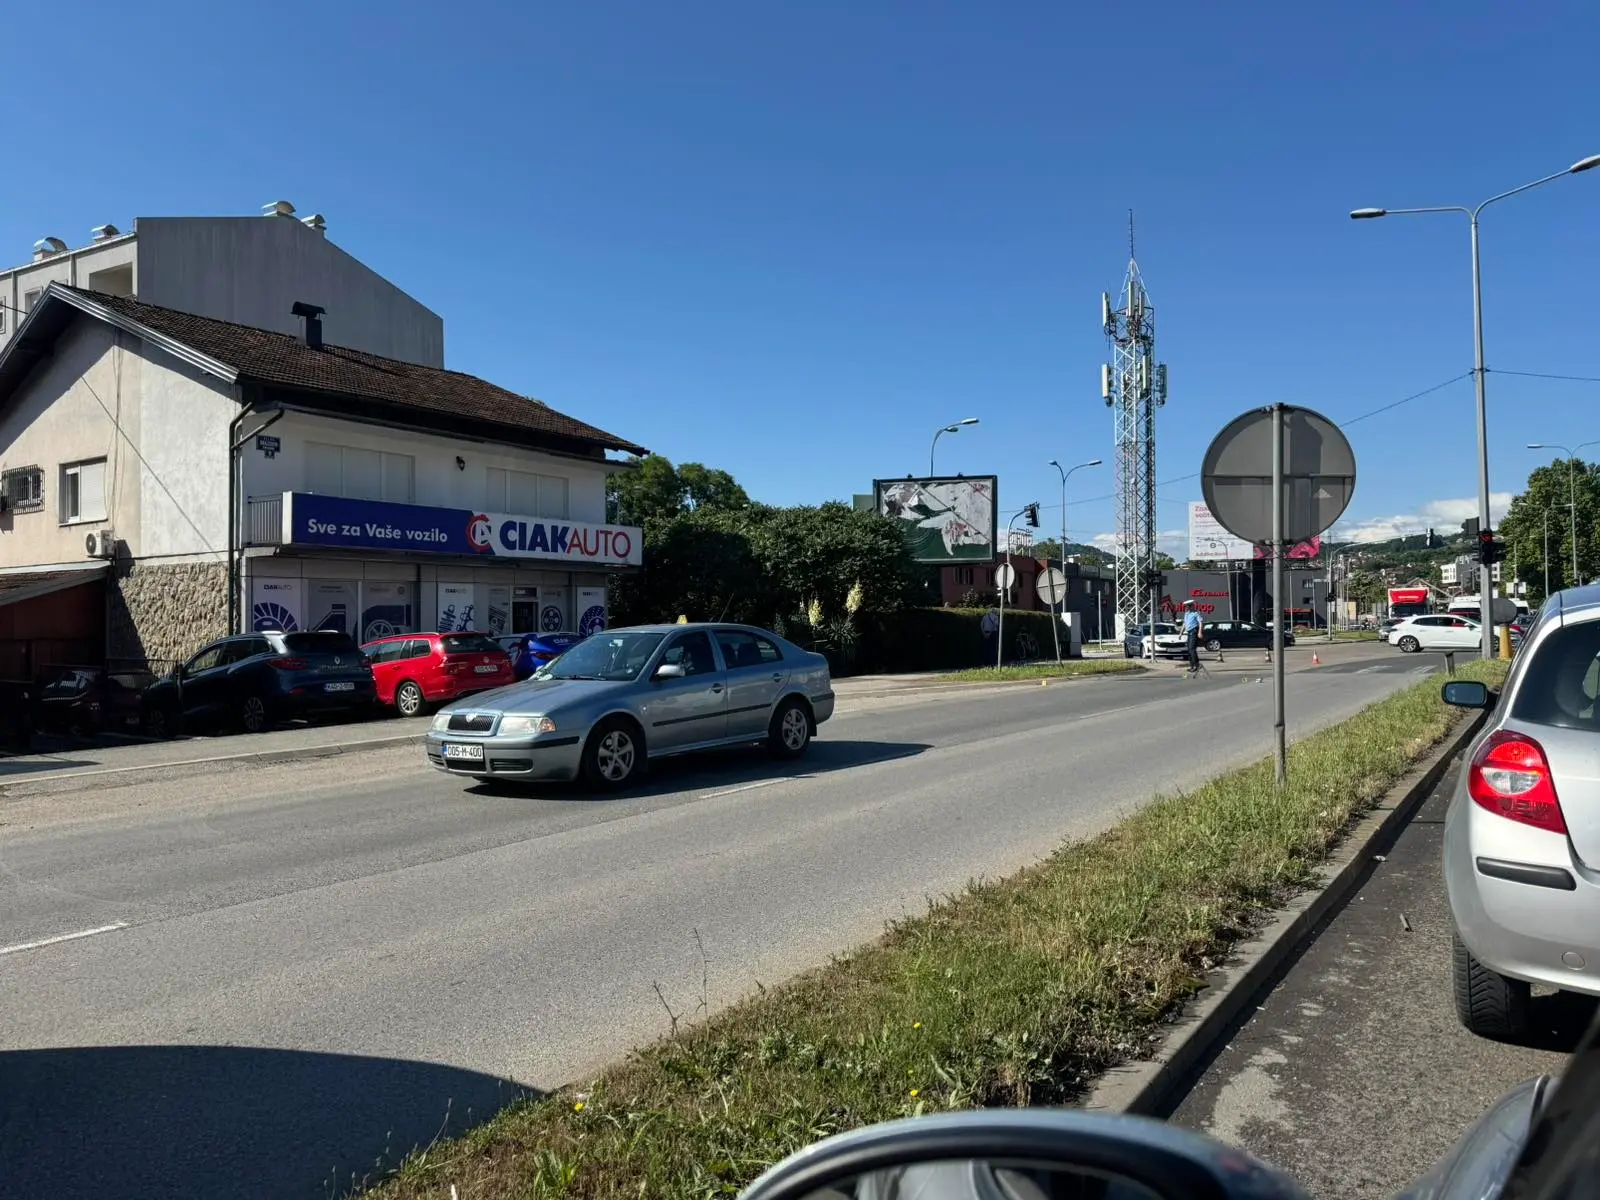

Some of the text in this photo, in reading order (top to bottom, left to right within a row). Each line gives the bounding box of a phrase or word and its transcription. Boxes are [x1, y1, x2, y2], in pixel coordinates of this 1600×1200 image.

[308, 518, 448, 543] Sve za Vaše vozilo
[499, 519, 632, 559] CIAKAUTO
